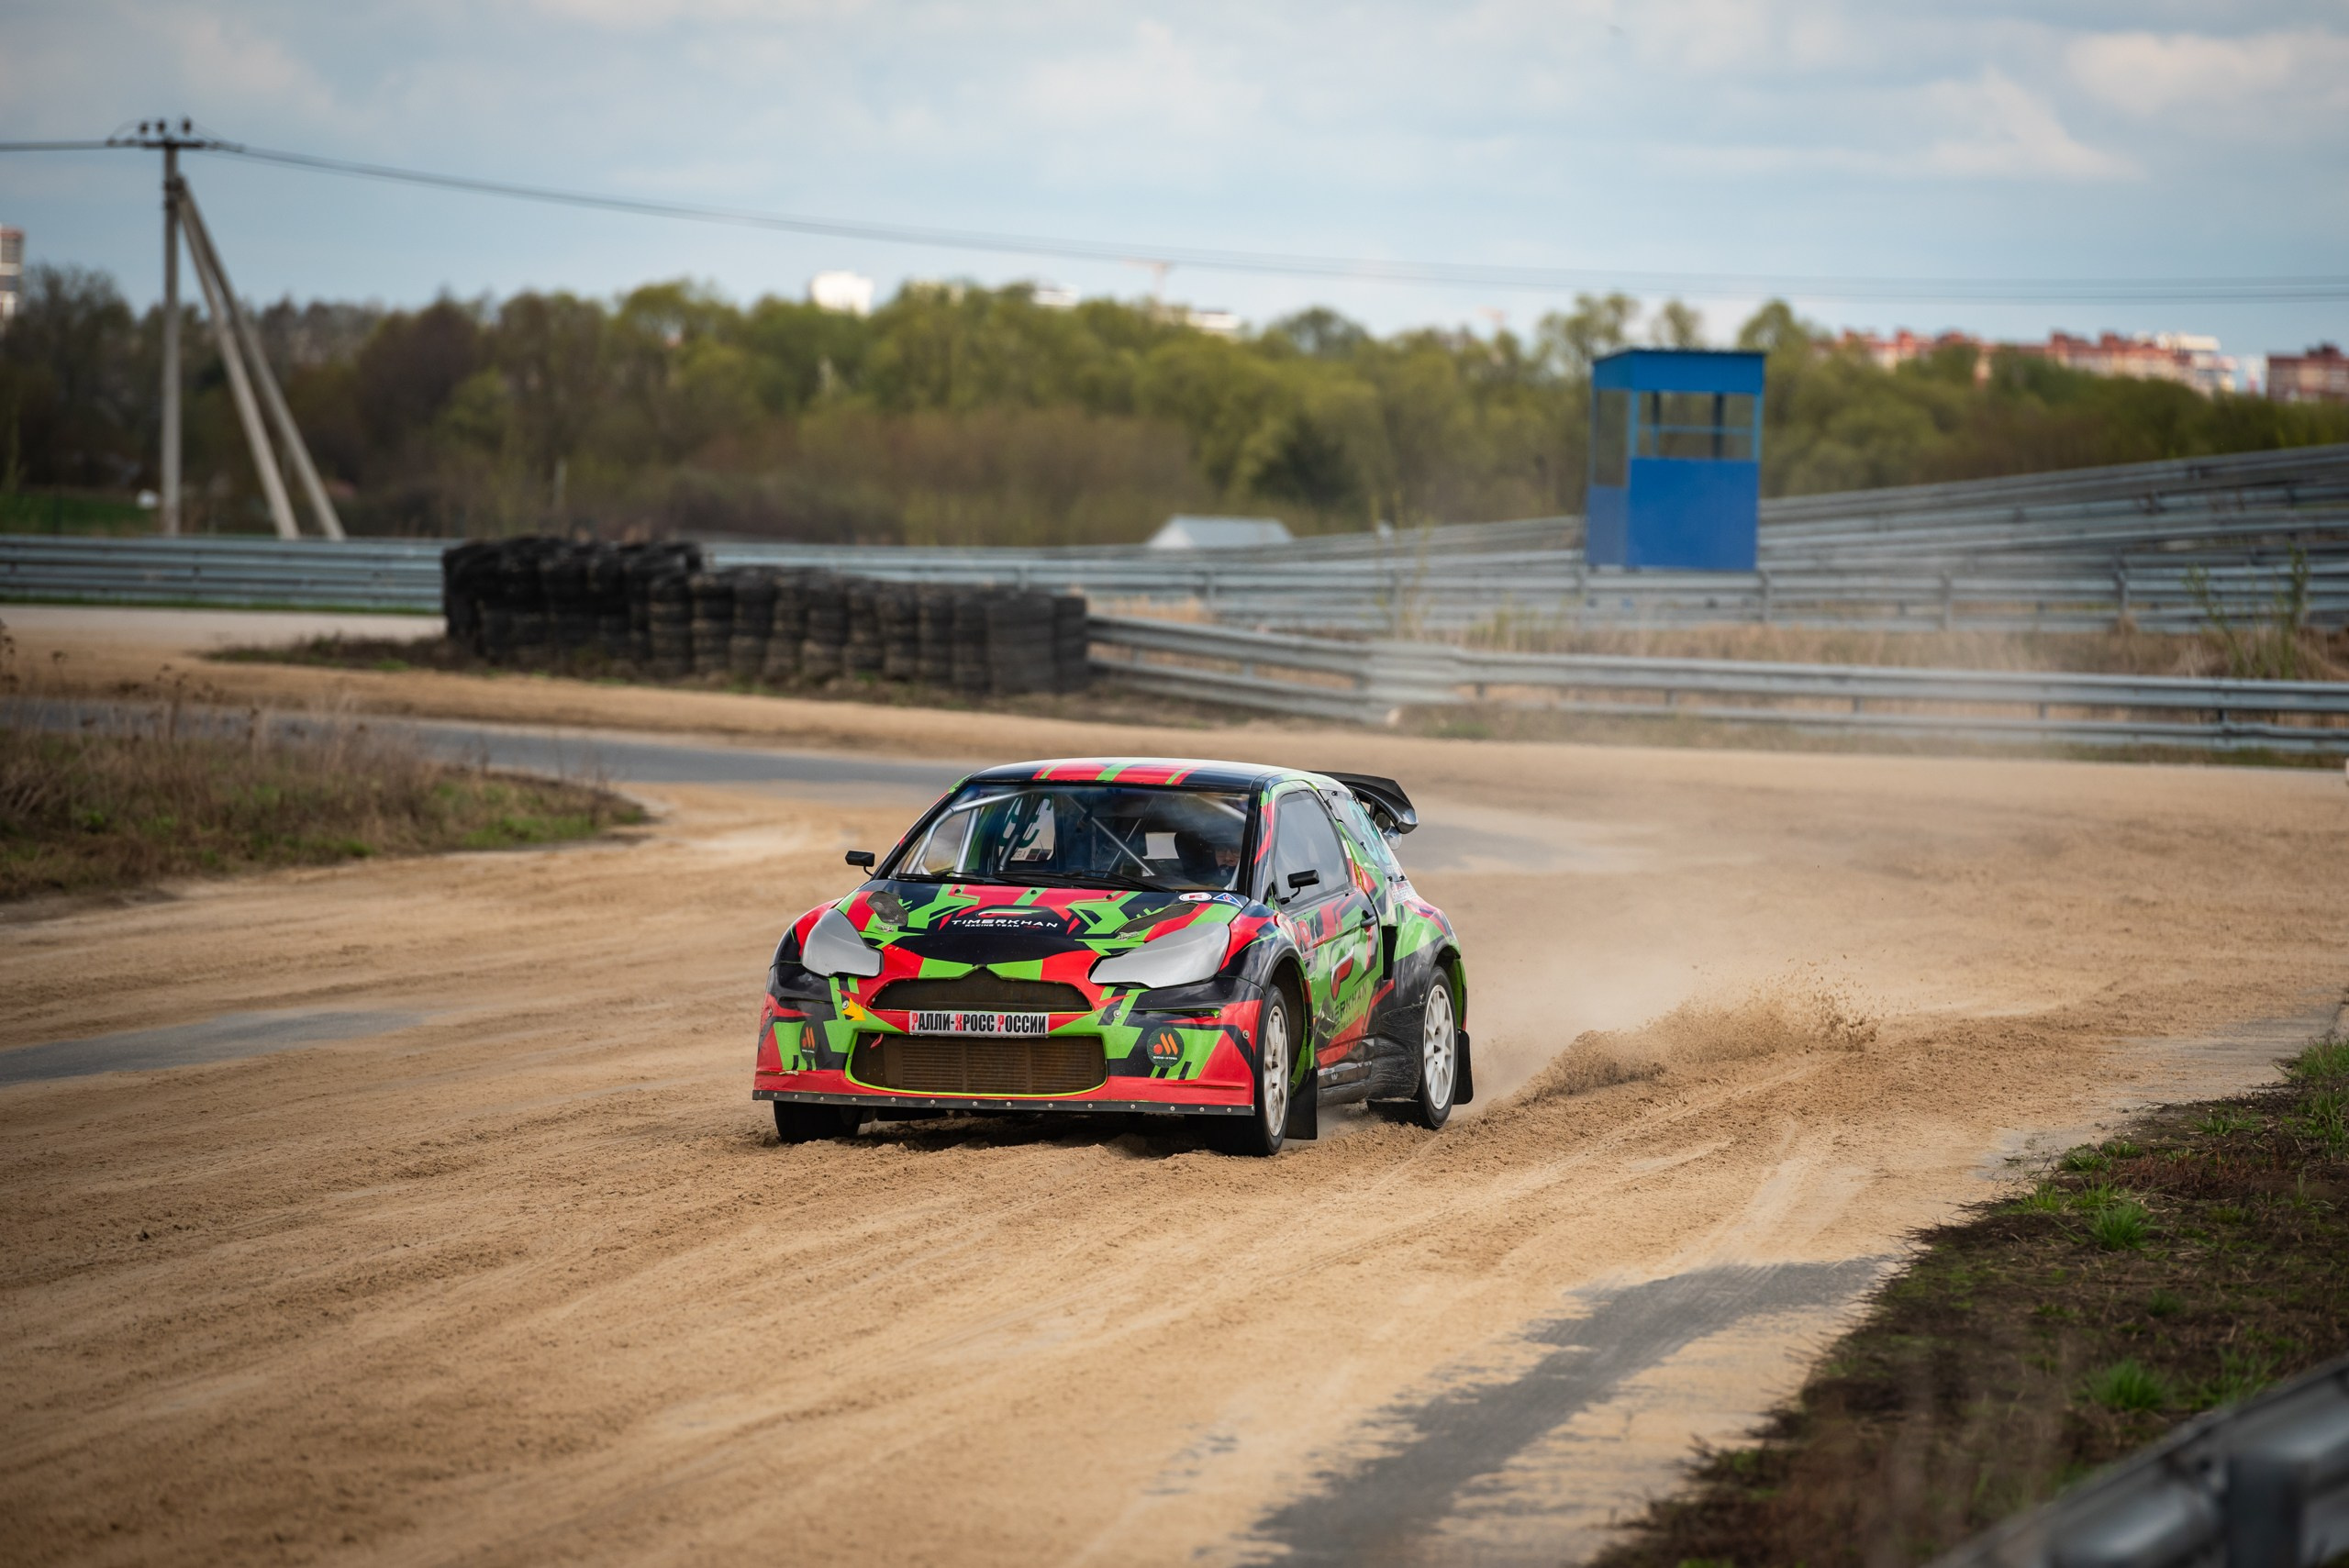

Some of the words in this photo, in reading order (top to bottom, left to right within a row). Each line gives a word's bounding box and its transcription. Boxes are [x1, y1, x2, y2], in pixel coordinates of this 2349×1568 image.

[952, 918, 1058, 929] TIMERKHAN
[911, 1013, 995, 1032] РАЛЛИ-КРОСС
[997, 1014, 1046, 1033] РОССИИ
